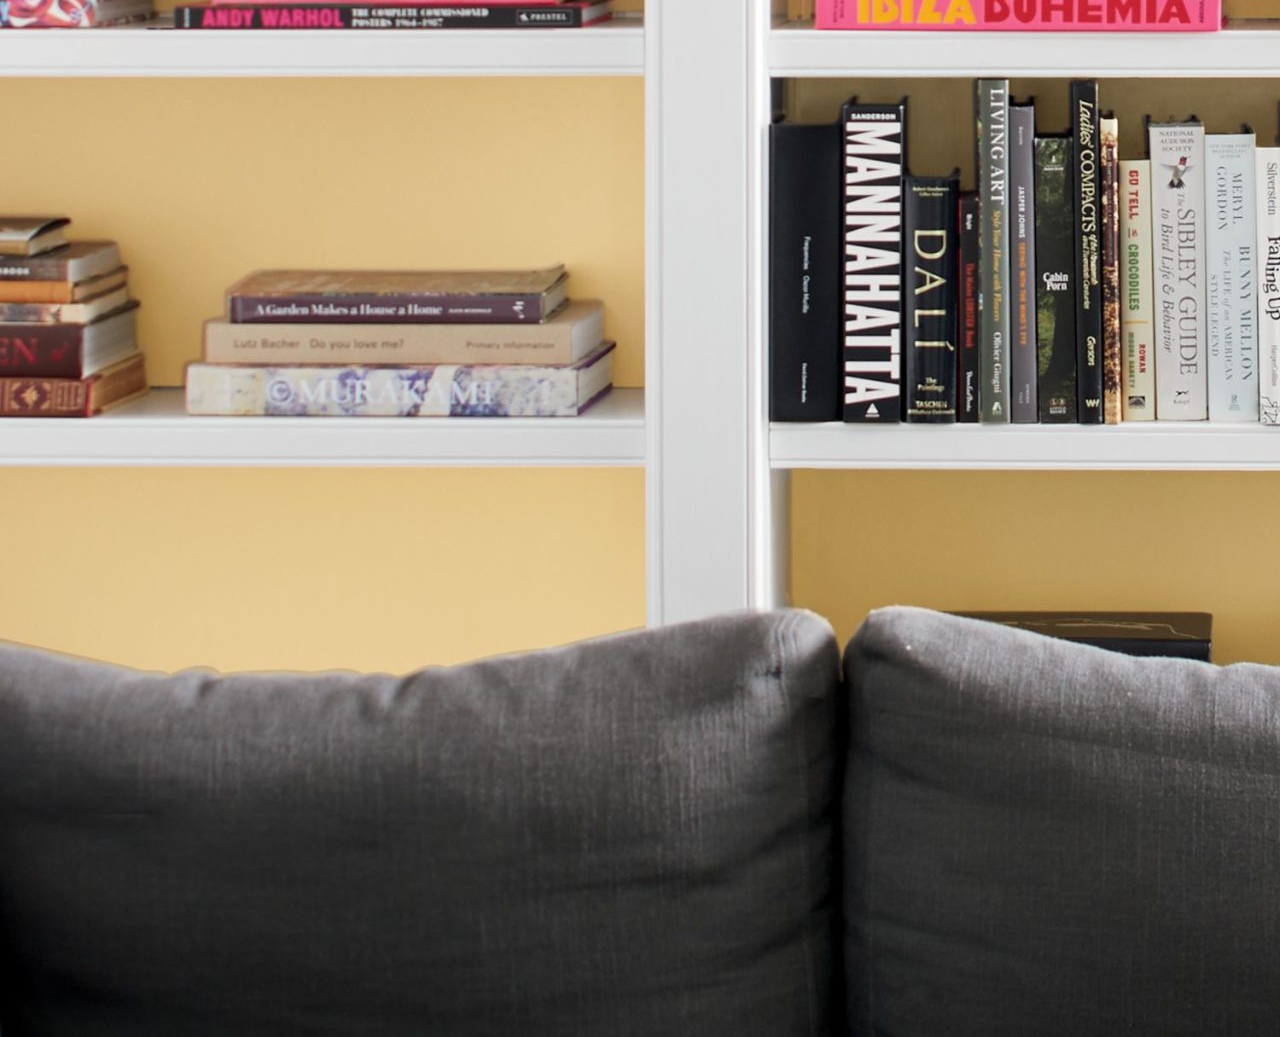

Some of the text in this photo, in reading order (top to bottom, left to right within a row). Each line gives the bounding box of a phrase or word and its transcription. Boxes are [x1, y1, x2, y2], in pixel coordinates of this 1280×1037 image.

[202, 8, 345, 28] ANDY WARHOL
[990, 89, 1004, 205] LIVING ART
[1128, 170, 1139, 220] GO TELL
[845, 122, 901, 404] MANNAHATTA
[255, 303, 264, 315] A
[265, 303, 308, 315] Garden
[310, 303, 348, 315] Makes
[349, 305, 358, 315] a
[360, 304, 396, 315] House
[397, 305, 406, 315] a
[408, 304, 443, 315] Home
[233, 338, 556, 351] Lutz Bacher Do you love me? Primary Information
